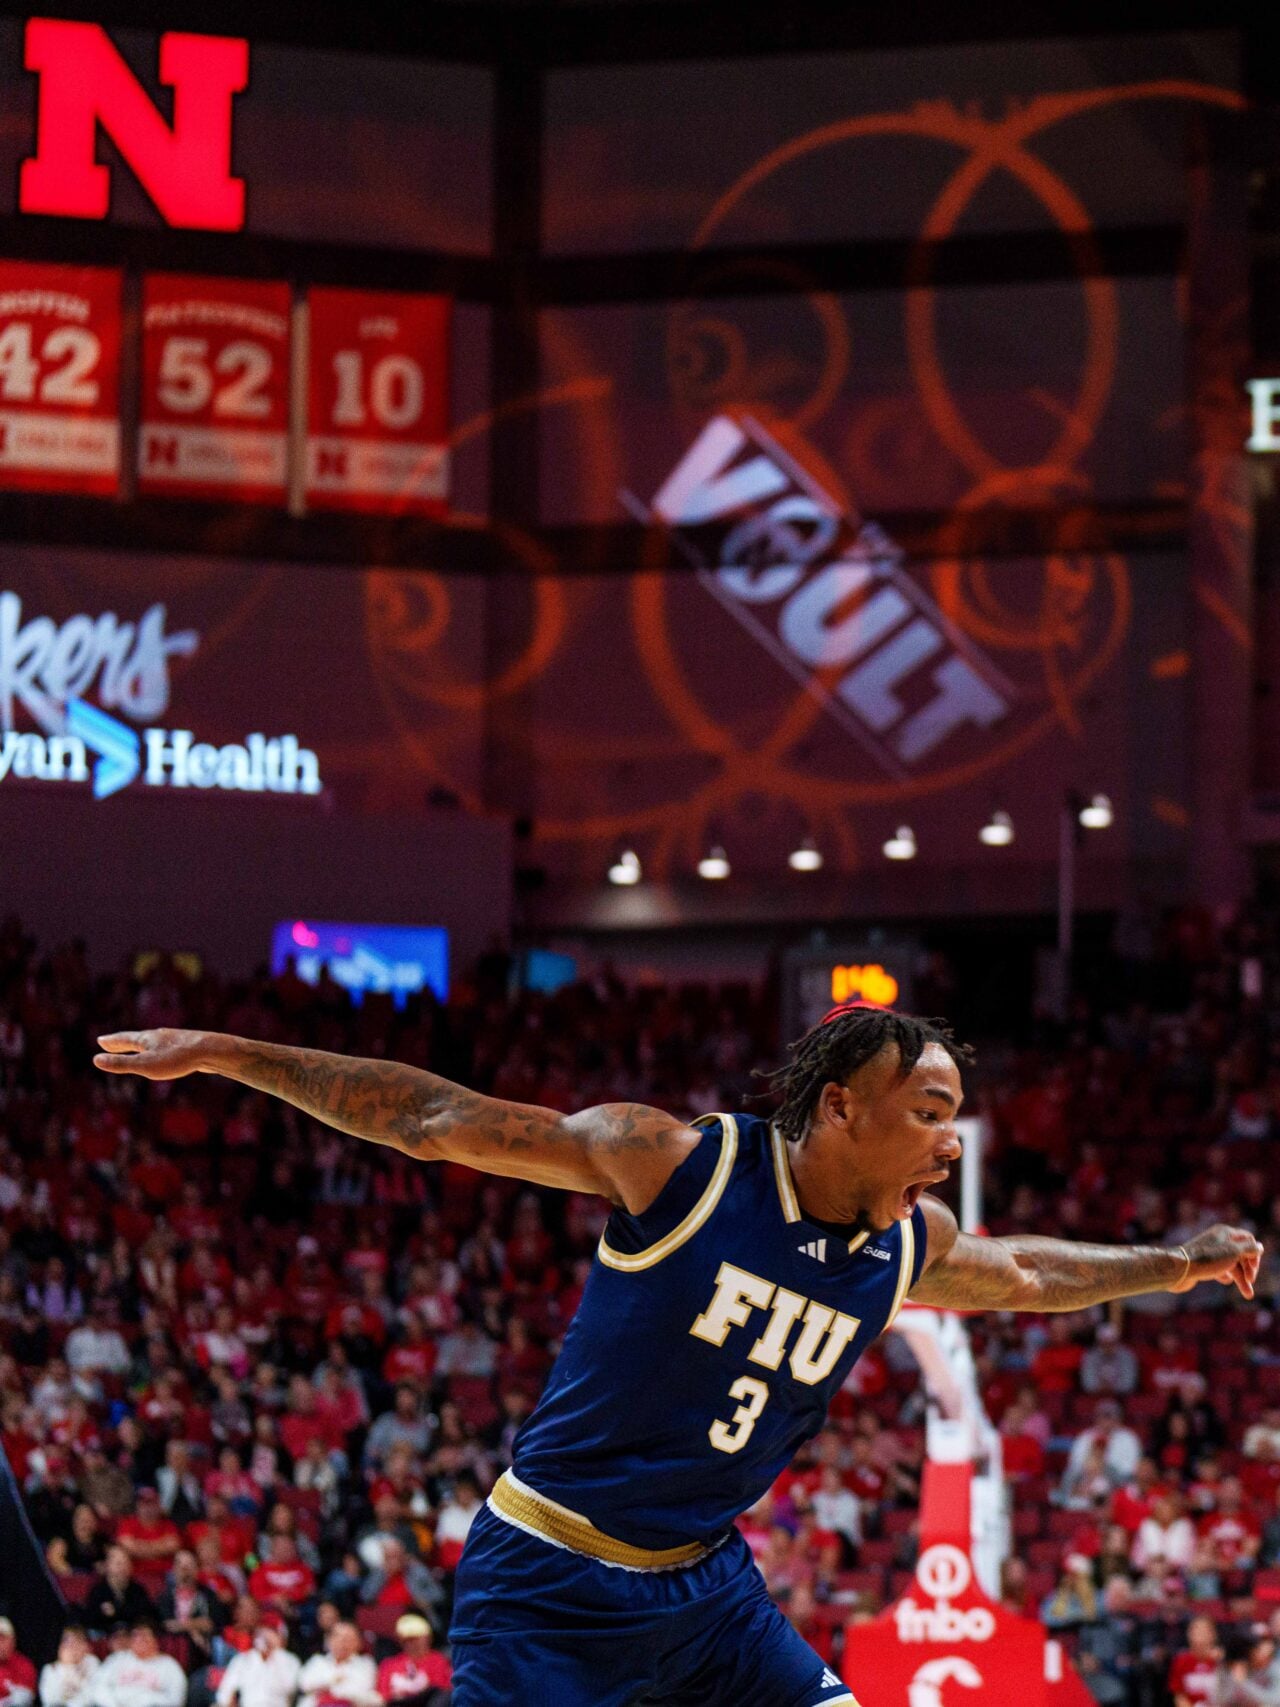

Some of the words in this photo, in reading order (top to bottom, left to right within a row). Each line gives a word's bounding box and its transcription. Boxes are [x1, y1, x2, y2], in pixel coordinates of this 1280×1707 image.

[20, 17, 249, 232] N
[0, 323, 99, 403] 42
[157, 335, 273, 418] 52
[332, 350, 424, 430] 10
[144, 728, 323, 795] Health
[688, 1260, 862, 1386] FIU
[708, 1375, 770, 1454] 3
